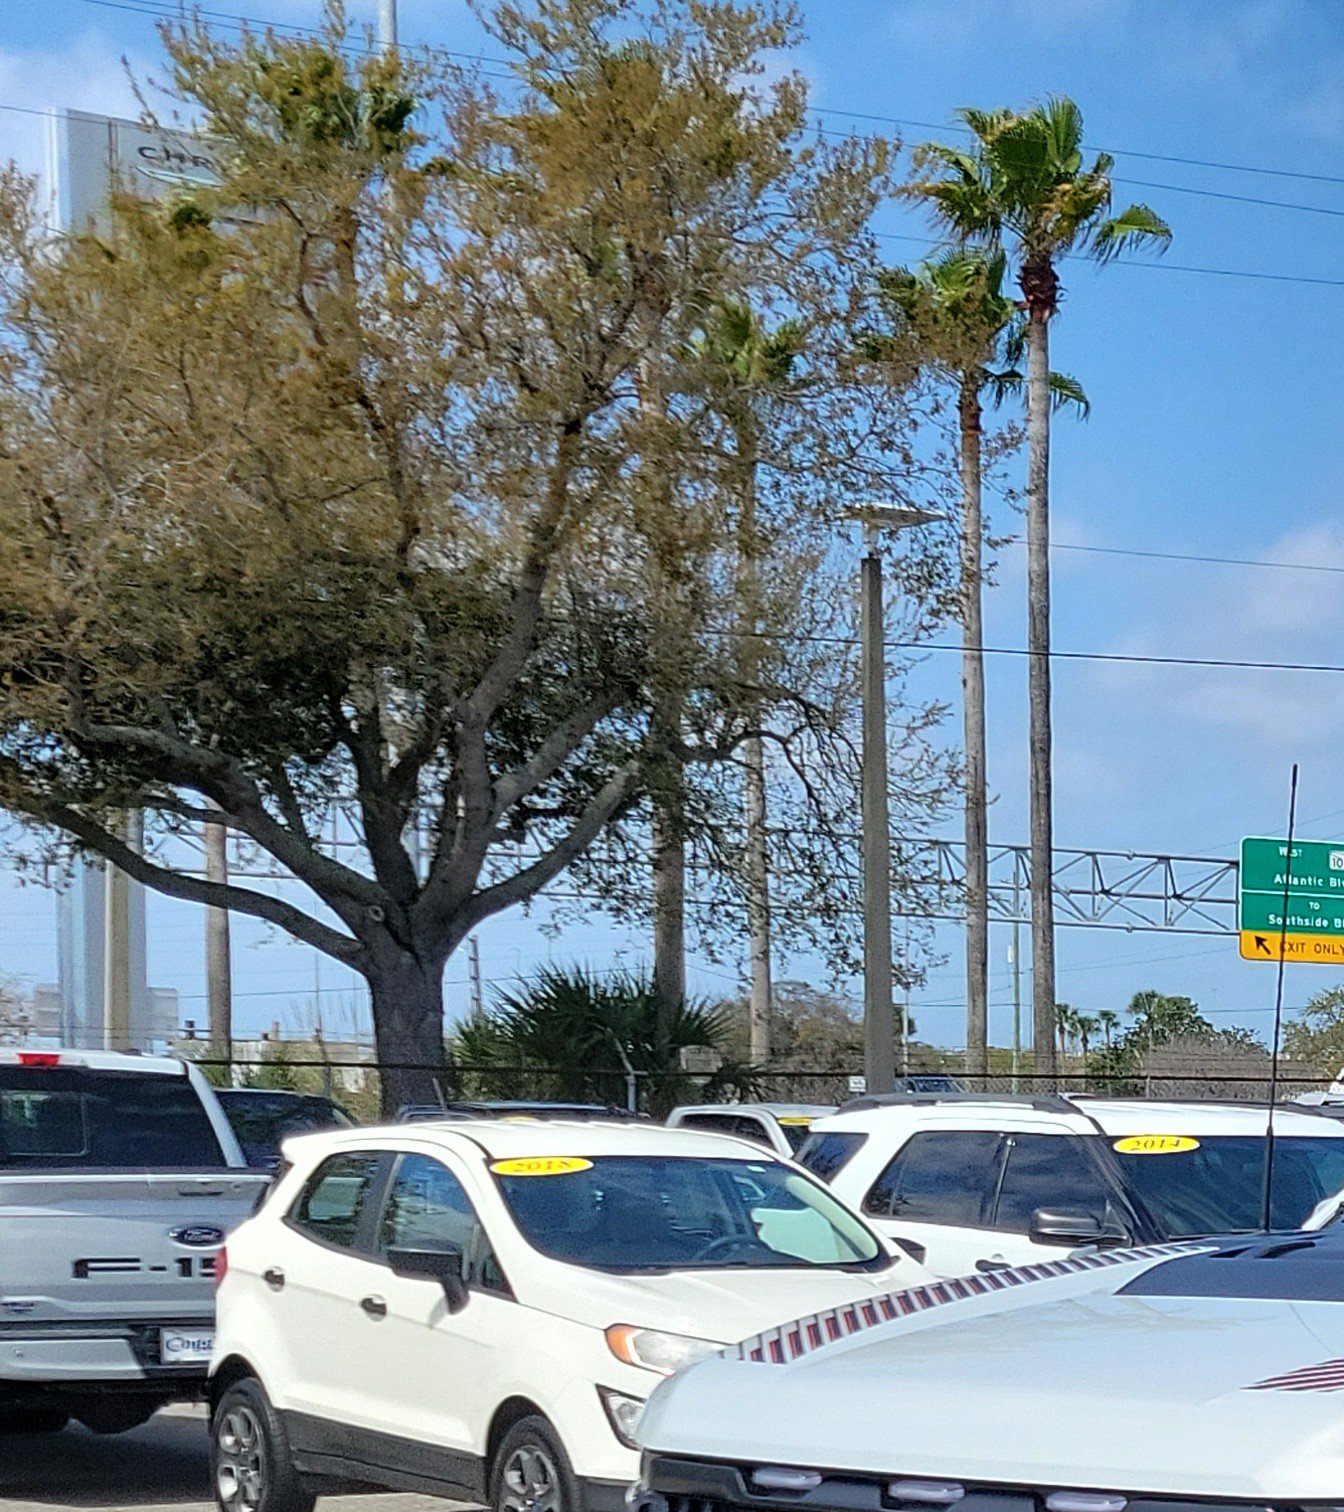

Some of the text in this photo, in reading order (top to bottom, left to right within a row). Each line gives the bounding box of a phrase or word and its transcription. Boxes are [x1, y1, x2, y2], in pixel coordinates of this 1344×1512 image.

[1279, 846, 1303, 857] WST
[1332, 857, 1344, 869] 10
[1129, 1139, 1181, 1151] 2014
